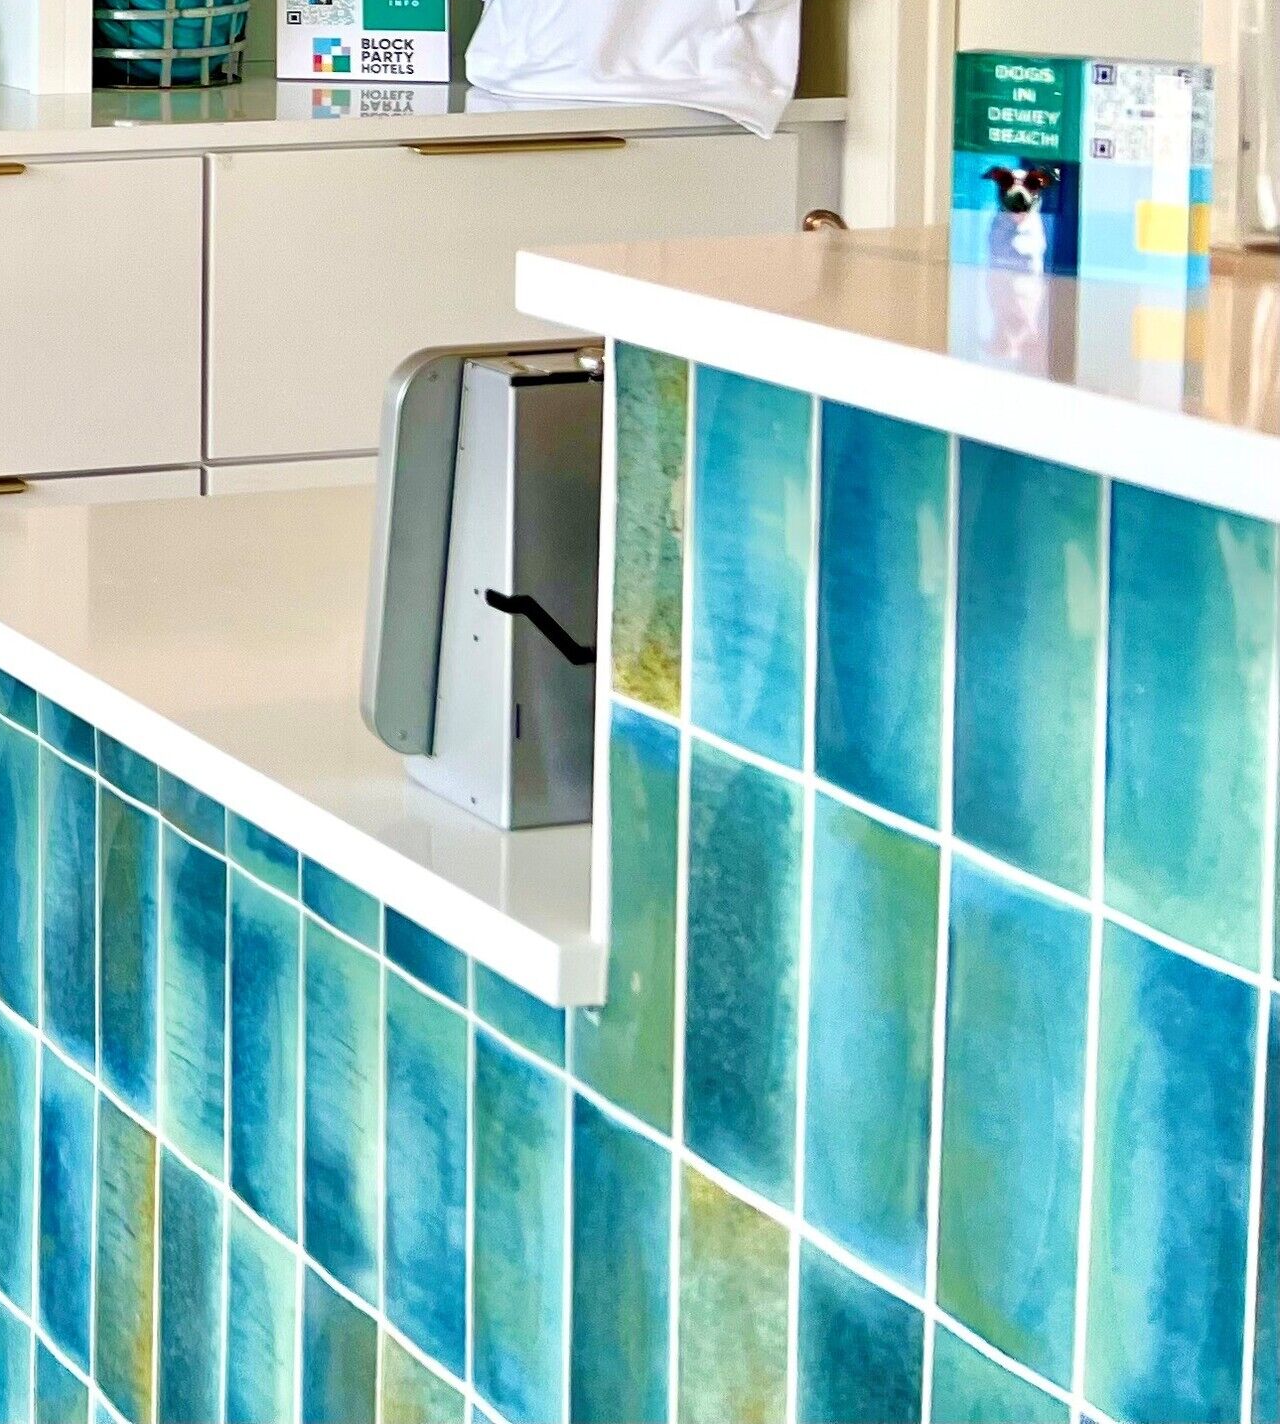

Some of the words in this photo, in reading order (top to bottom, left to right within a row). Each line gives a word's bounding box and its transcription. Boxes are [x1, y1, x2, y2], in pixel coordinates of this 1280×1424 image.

[361, 38, 415, 51] BLOCK
[361, 51, 415, 63] PARTY
[361, 63, 415, 75] HOTELS
[995, 64, 1056, 84] DOGS
[1012, 87, 1037, 103] IN
[988, 106, 1061, 125] DEWEY
[988, 127, 1059, 148] BEACH
